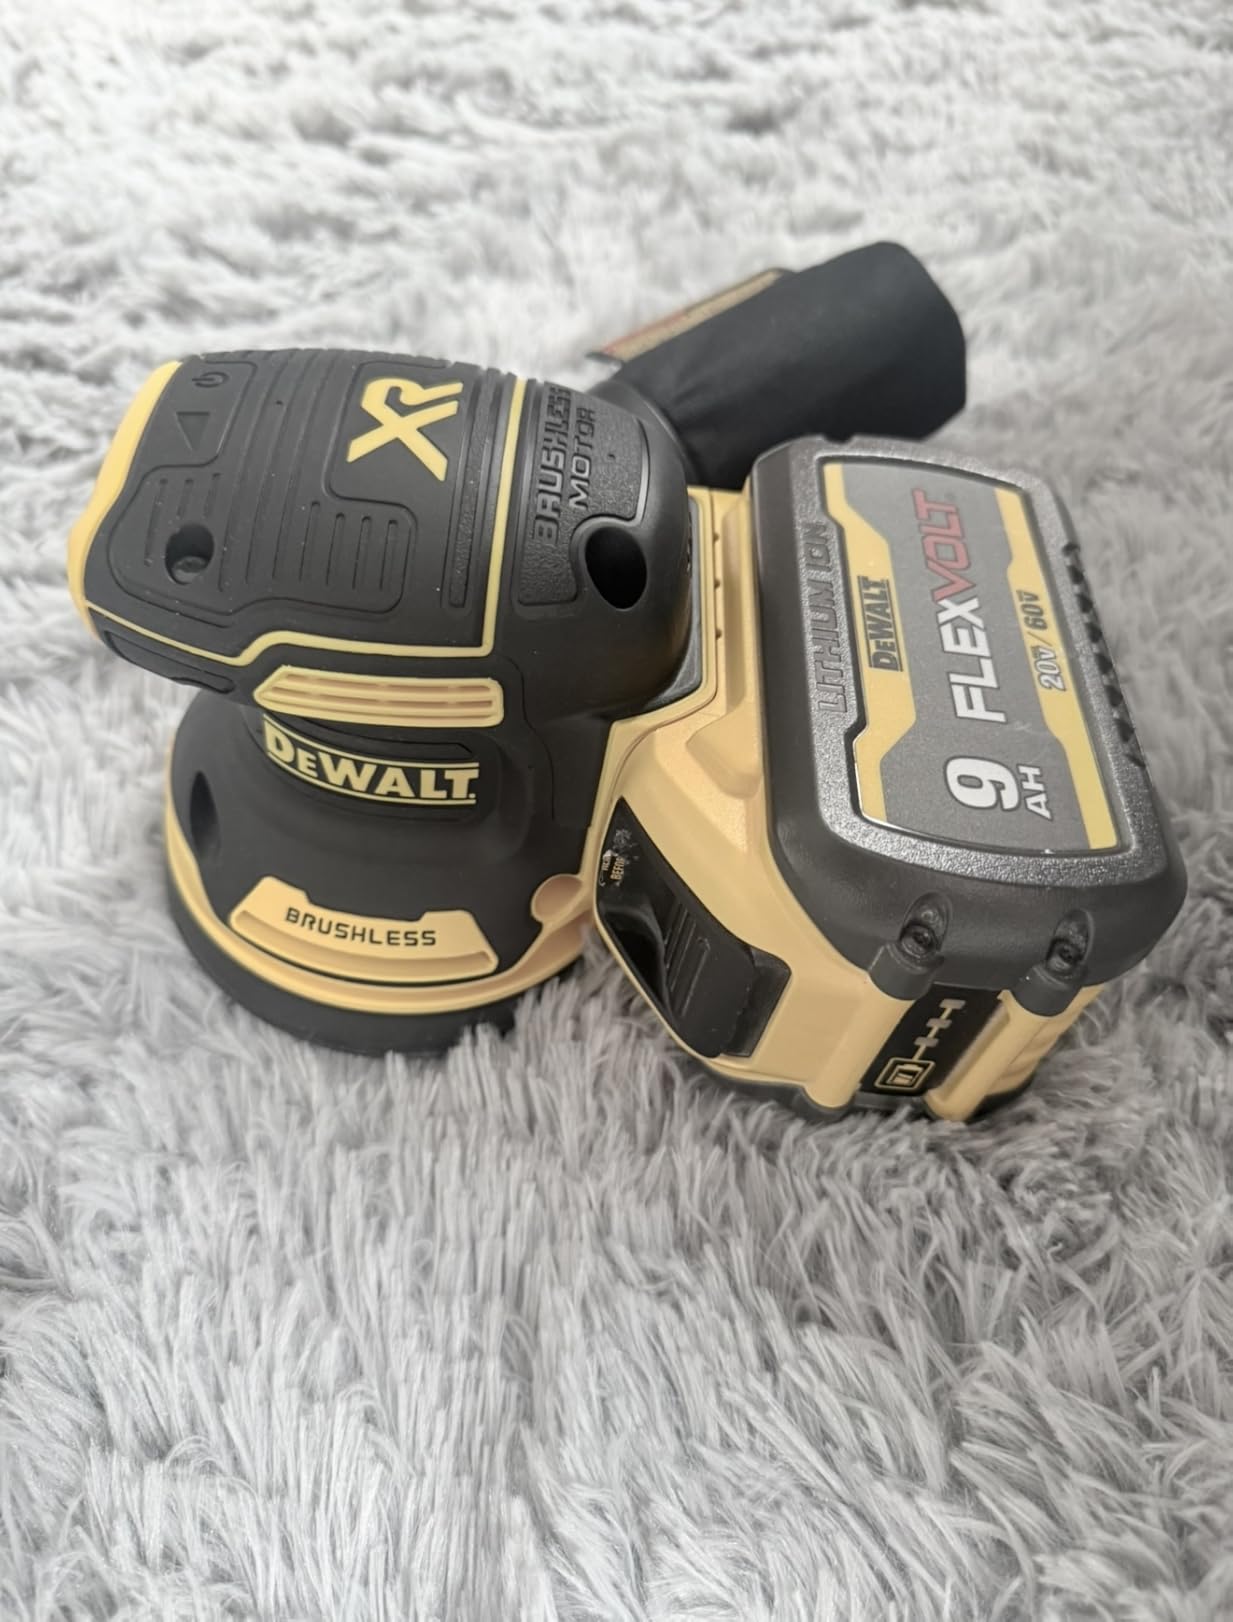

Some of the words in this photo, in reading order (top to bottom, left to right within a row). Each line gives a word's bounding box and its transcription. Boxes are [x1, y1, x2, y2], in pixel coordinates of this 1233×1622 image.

[346, 377, 464, 482] XR
[568, 407, 597, 511] MOTOR
[803, 522, 832, 573] ION
[807, 577, 848, 713] LITHIUM
[911, 487, 1008, 724] FLEXVOLT
[944, 756, 1021, 812] 9
[285, 906, 437, 947] BRUSHLESS
